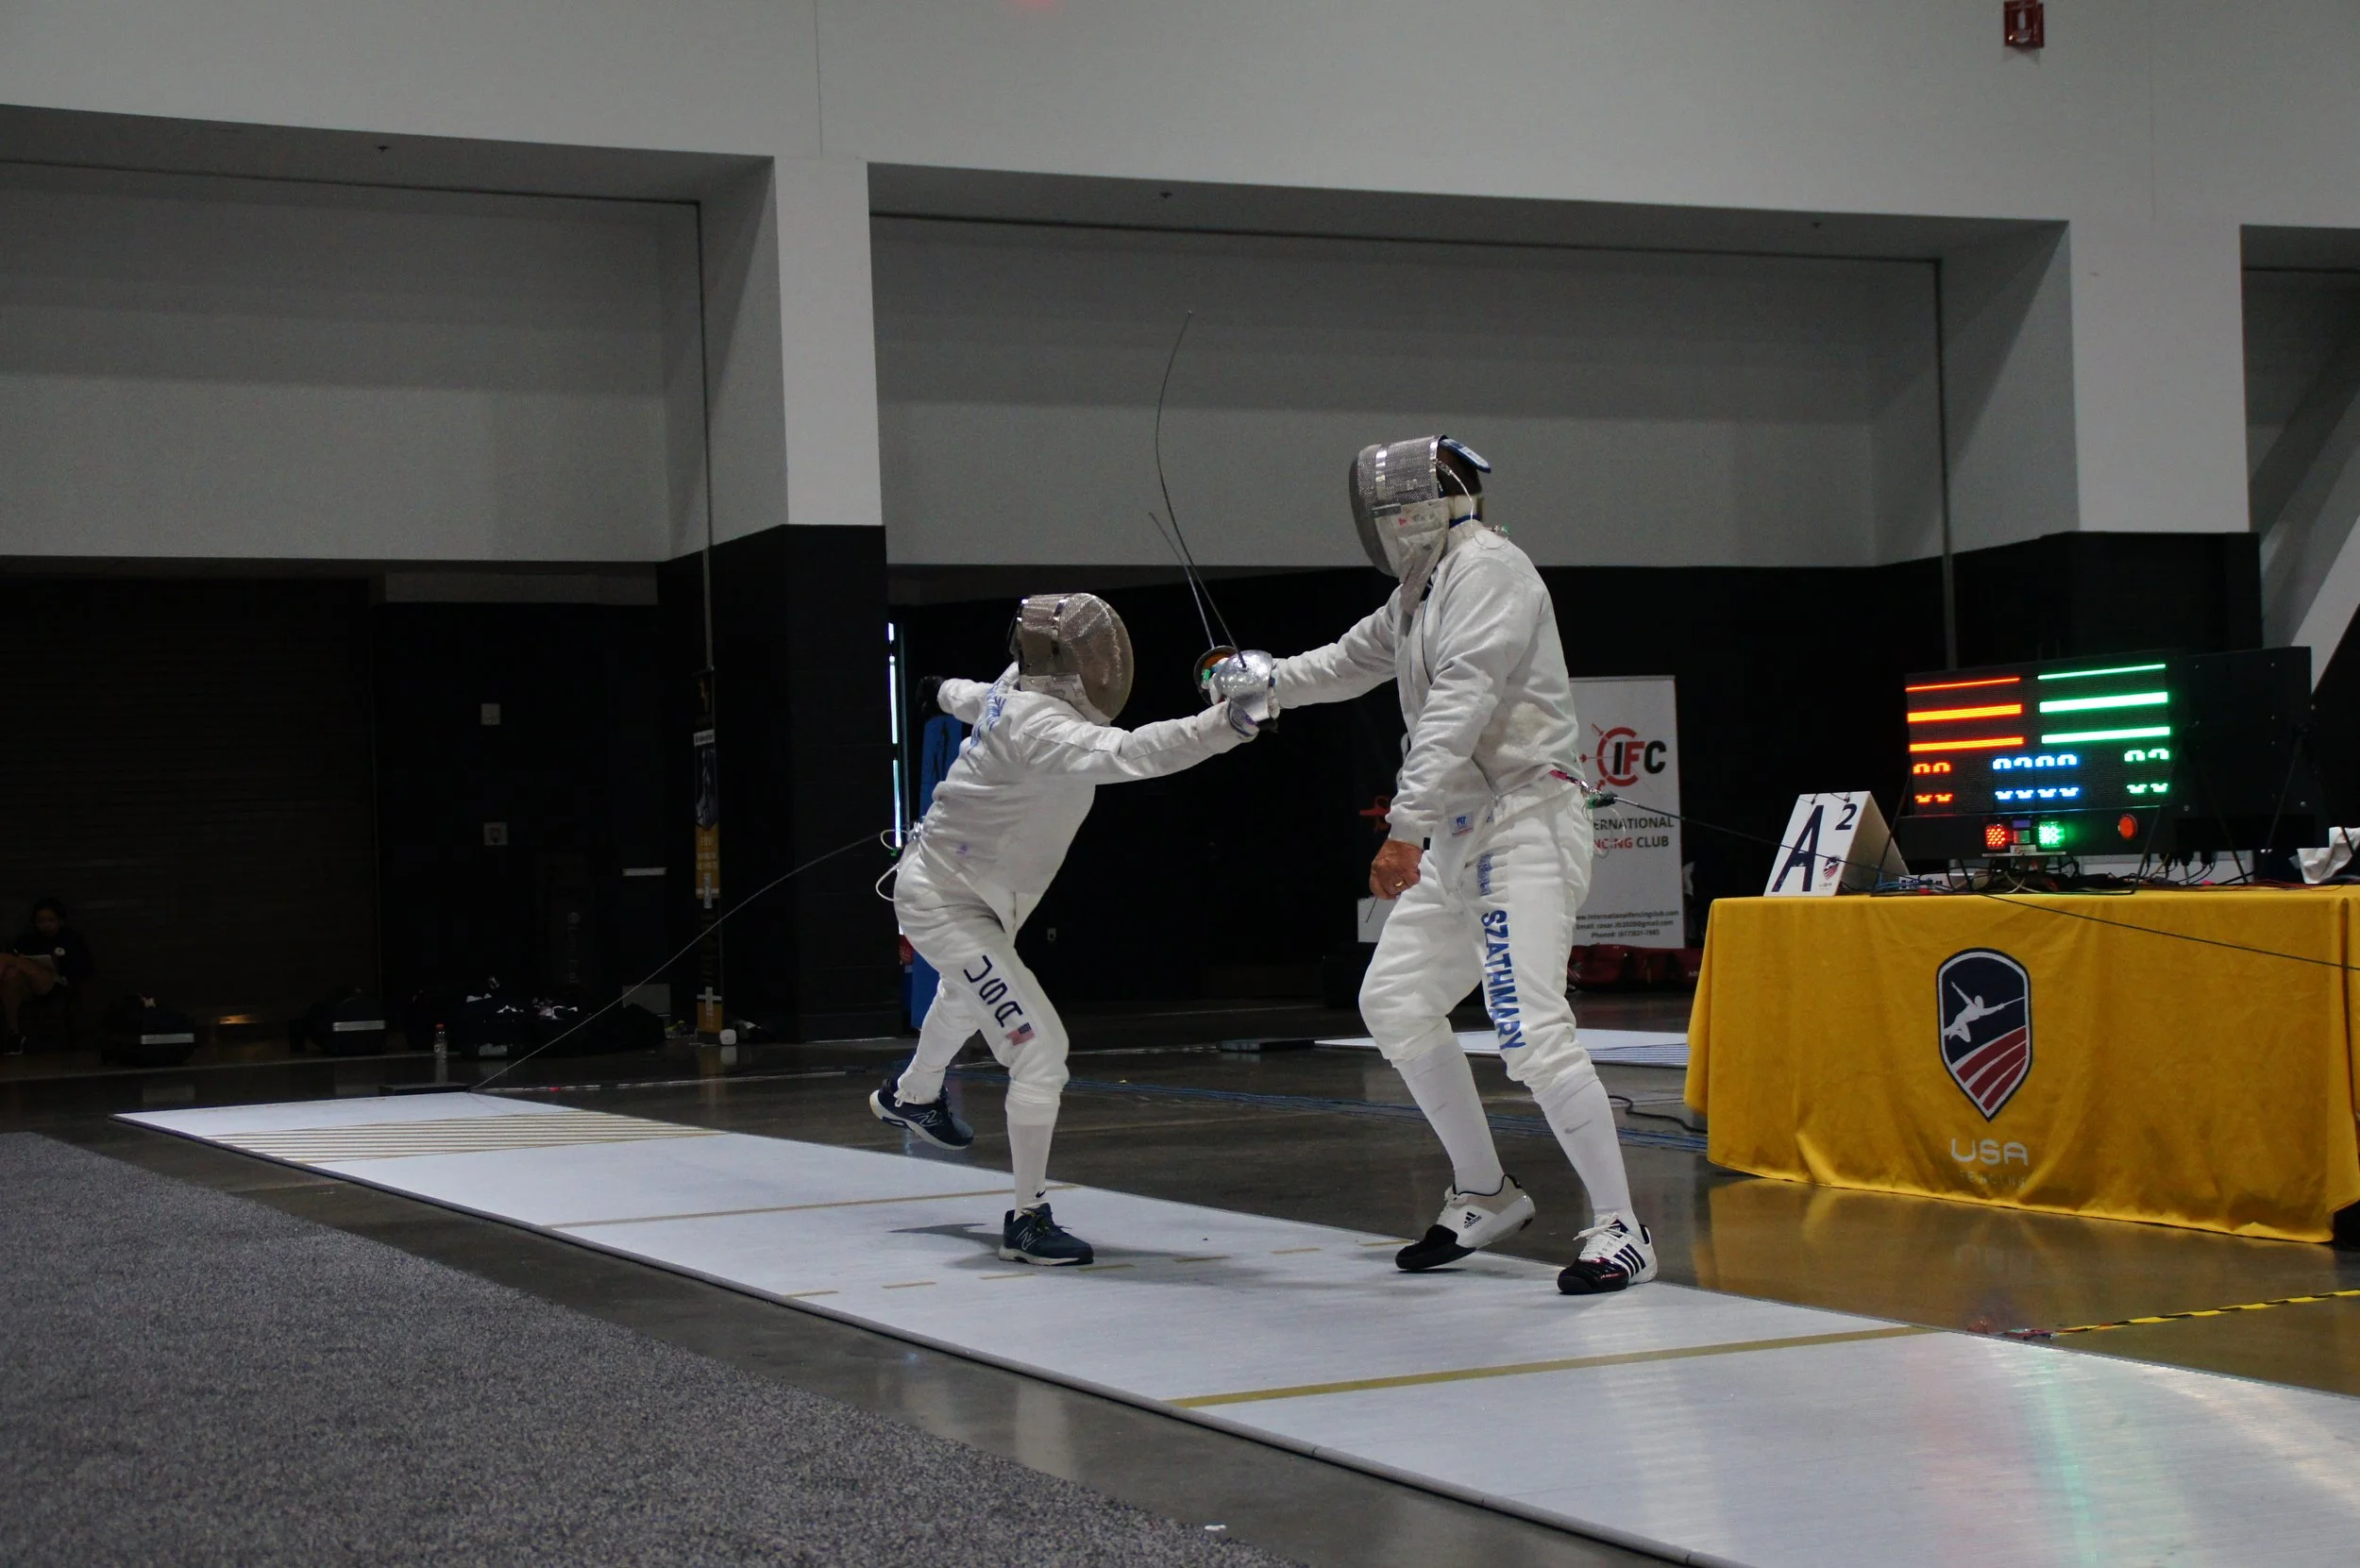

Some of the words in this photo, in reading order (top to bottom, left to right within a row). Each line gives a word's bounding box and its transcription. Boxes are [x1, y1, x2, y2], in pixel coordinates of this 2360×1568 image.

[1612, 740, 1667, 776] IFC
[1593, 817, 1675, 831] ERNATIONAL
[1593, 837, 1633, 850] NCNG
[1636, 835, 1669, 848] CLUB
[1771, 804, 1825, 893] A
[1835, 802, 1858, 831] 2
[963, 954, 1023, 1028] USA
[1480, 909, 1526, 1050] SZATHMARY
[1950, 1138, 2029, 1166] USA
[1463, 1215, 1482, 1229] adidas
